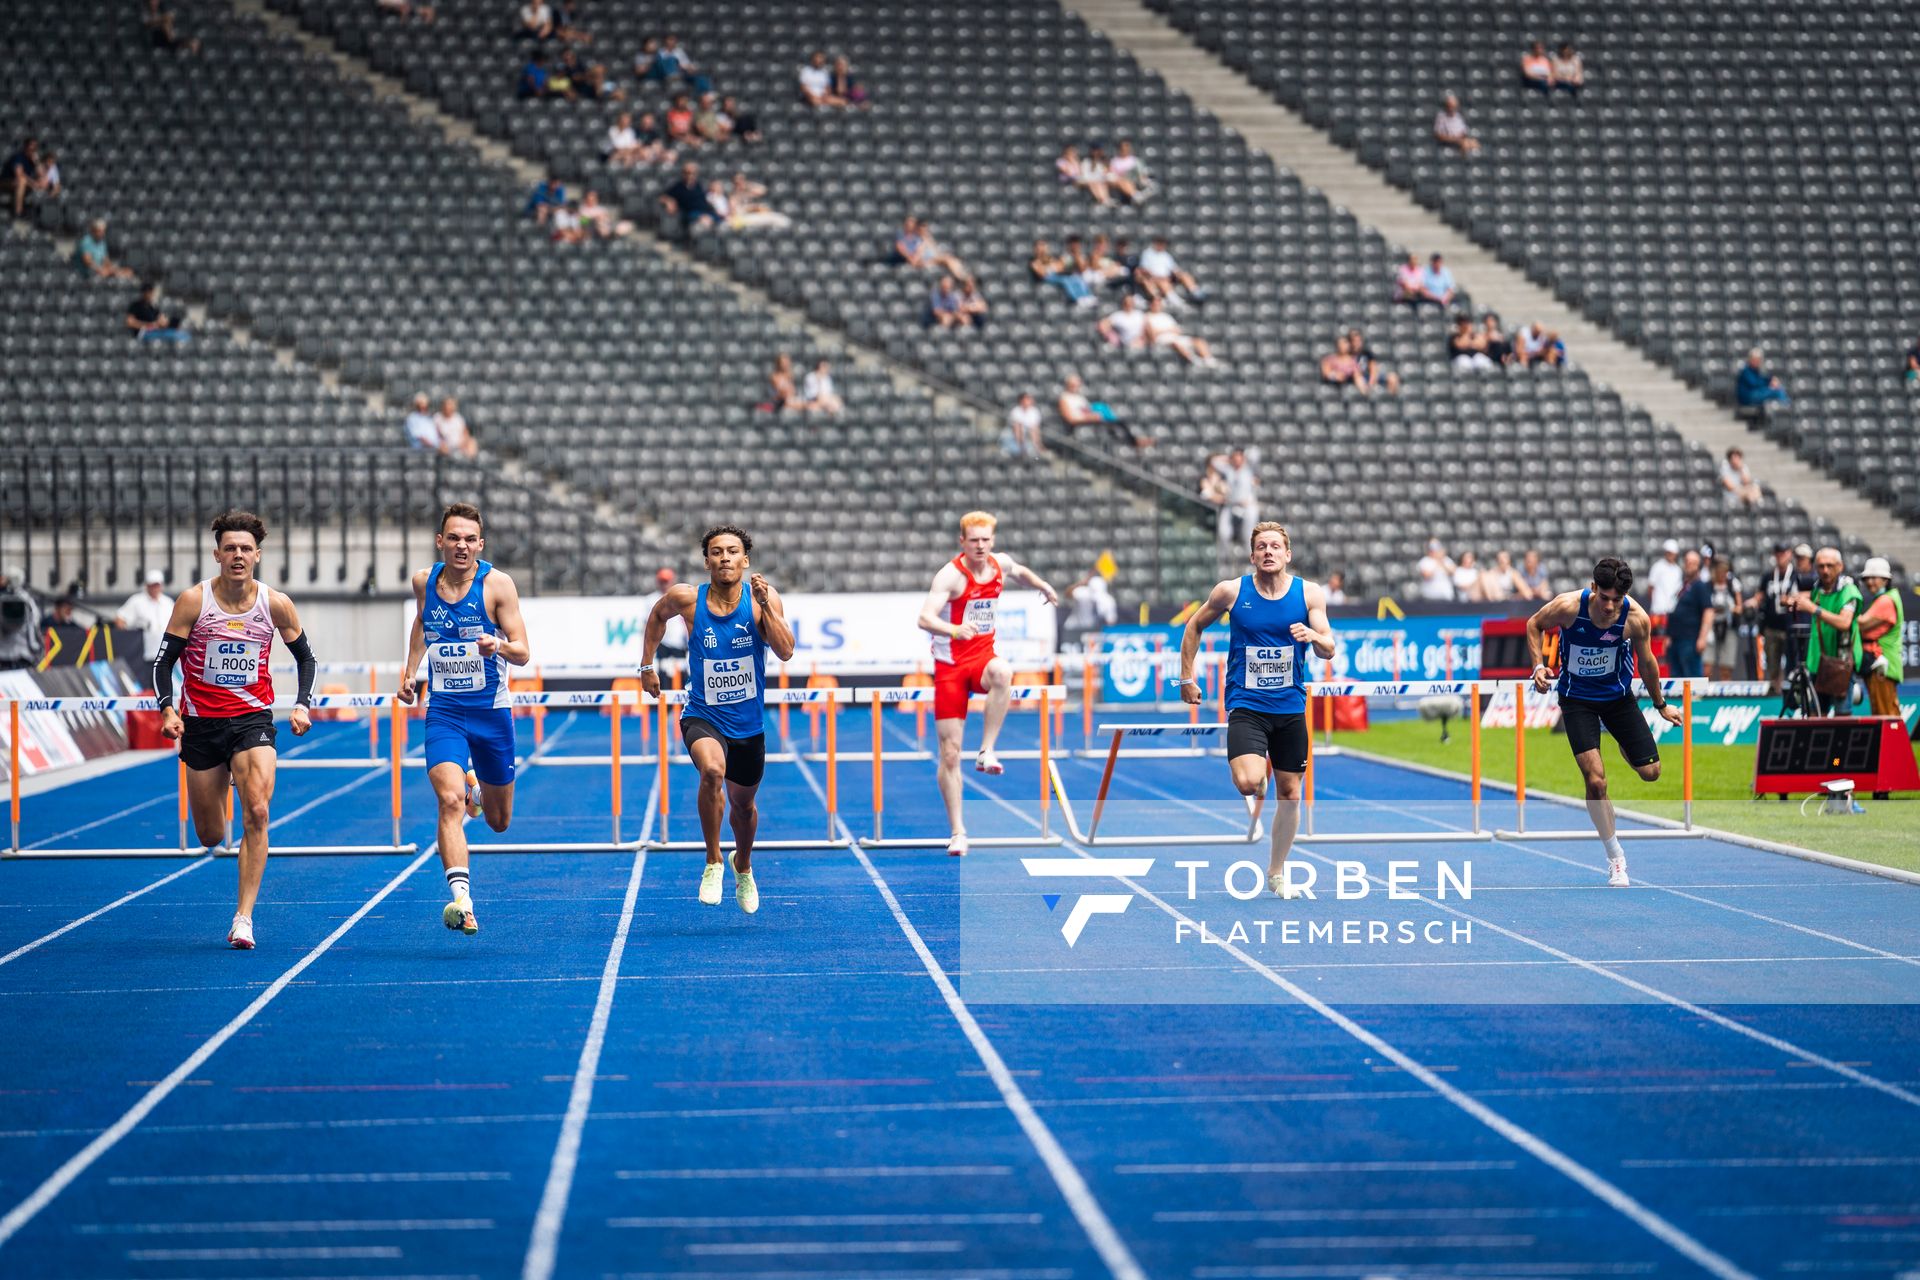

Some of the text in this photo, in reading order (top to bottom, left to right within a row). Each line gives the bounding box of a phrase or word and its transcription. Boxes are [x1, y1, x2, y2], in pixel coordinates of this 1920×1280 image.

[208, 657, 256, 671] L. ROOS
[1577, 655, 1609, 666] GACIC
[433, 660, 482, 674] LEWANDOWSKI
[707, 672, 752, 689] GORDON
[1268, 676, 1283, 684] PLAN
[728, 690, 746, 698] PLAN
[1317, 687, 1343, 696] ANA
[1373, 686, 1398, 695] ANA
[1428, 685, 1454, 694] ANA
[514, 695, 539, 704] ANA
[568, 694, 595, 704] ANA
[783, 692, 810, 701] ANA
[885, 691, 912, 700] ANA
[25, 700, 50, 710] ANA
[81, 700, 105, 710] ANA
[349, 697, 374, 706] ANA
[1128, 728, 1153, 736] ANA
